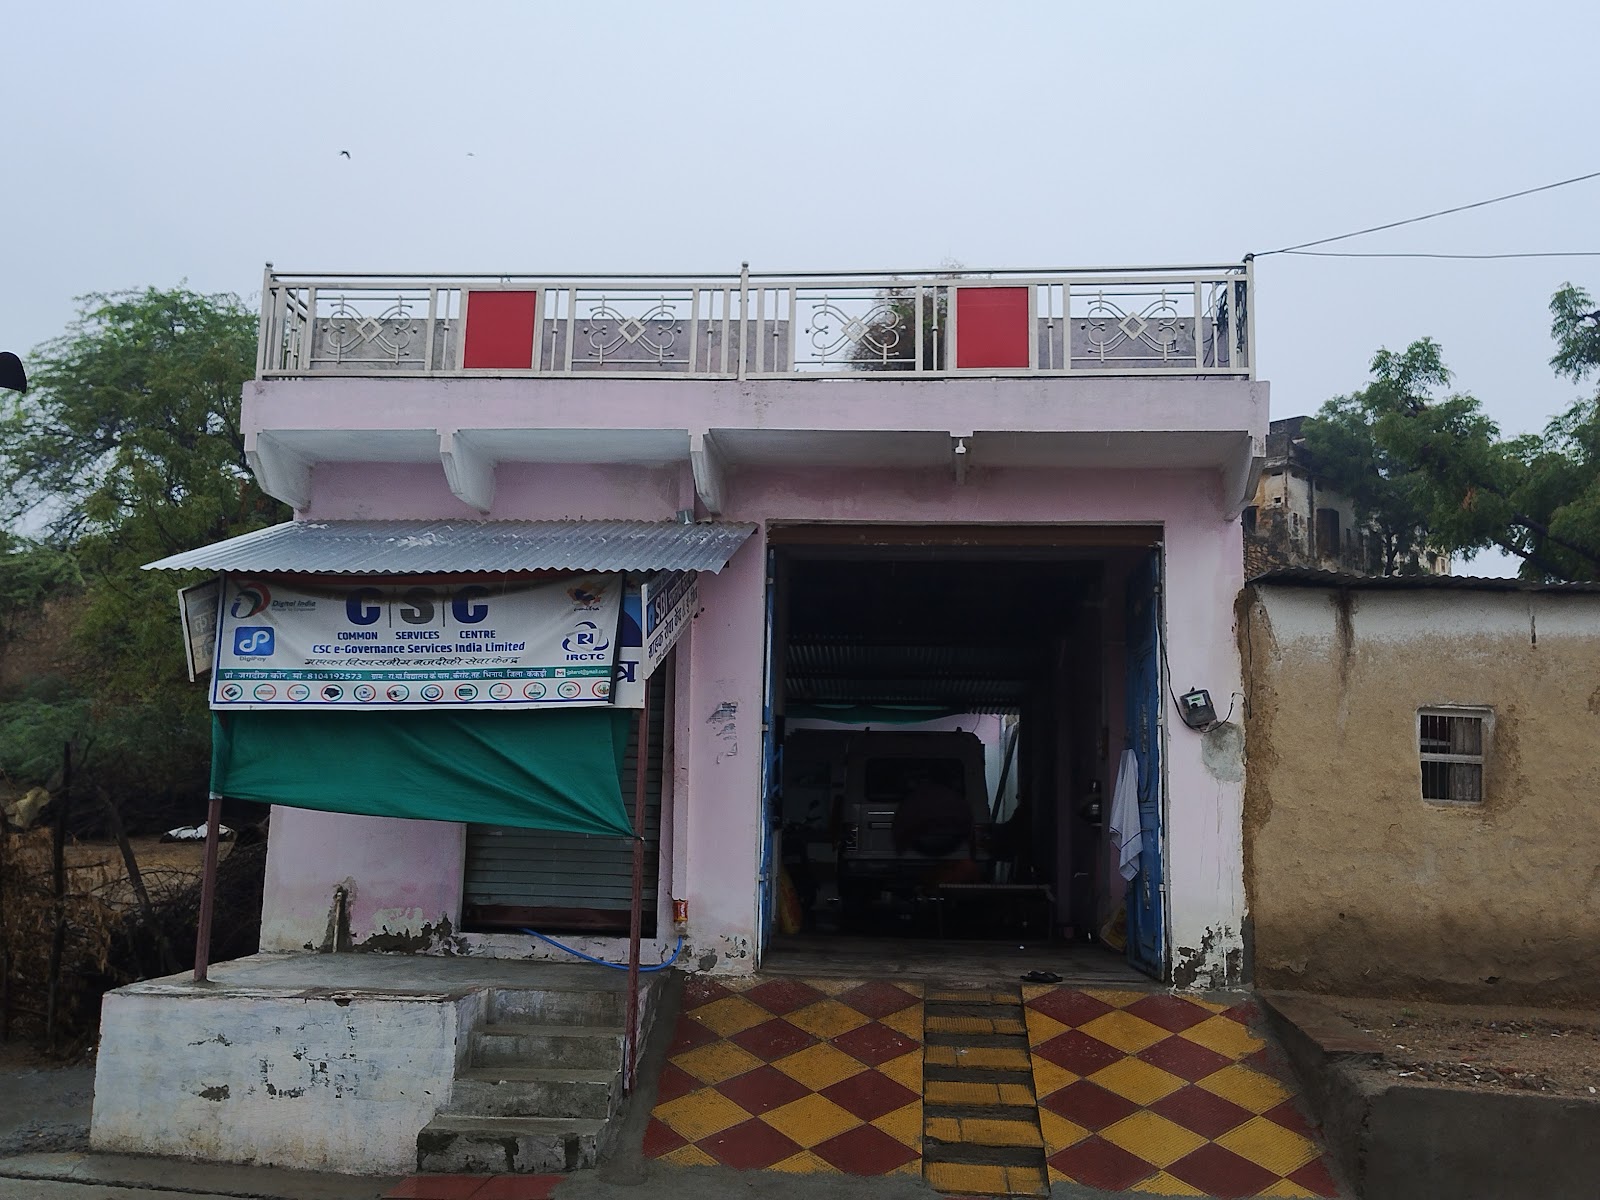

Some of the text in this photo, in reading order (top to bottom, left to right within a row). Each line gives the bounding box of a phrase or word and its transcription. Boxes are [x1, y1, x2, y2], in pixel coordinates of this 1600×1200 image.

[272, 599, 317, 608] Digital India
[656, 588, 668, 625] SBI
[337, 629, 496, 641] COMMON SERVICES CENTRE
[312, 641, 526, 654] CSC e-Governance Services India Limited
[464, 656, 491, 666] सेवा
[566, 653, 606, 662] IRCTC
